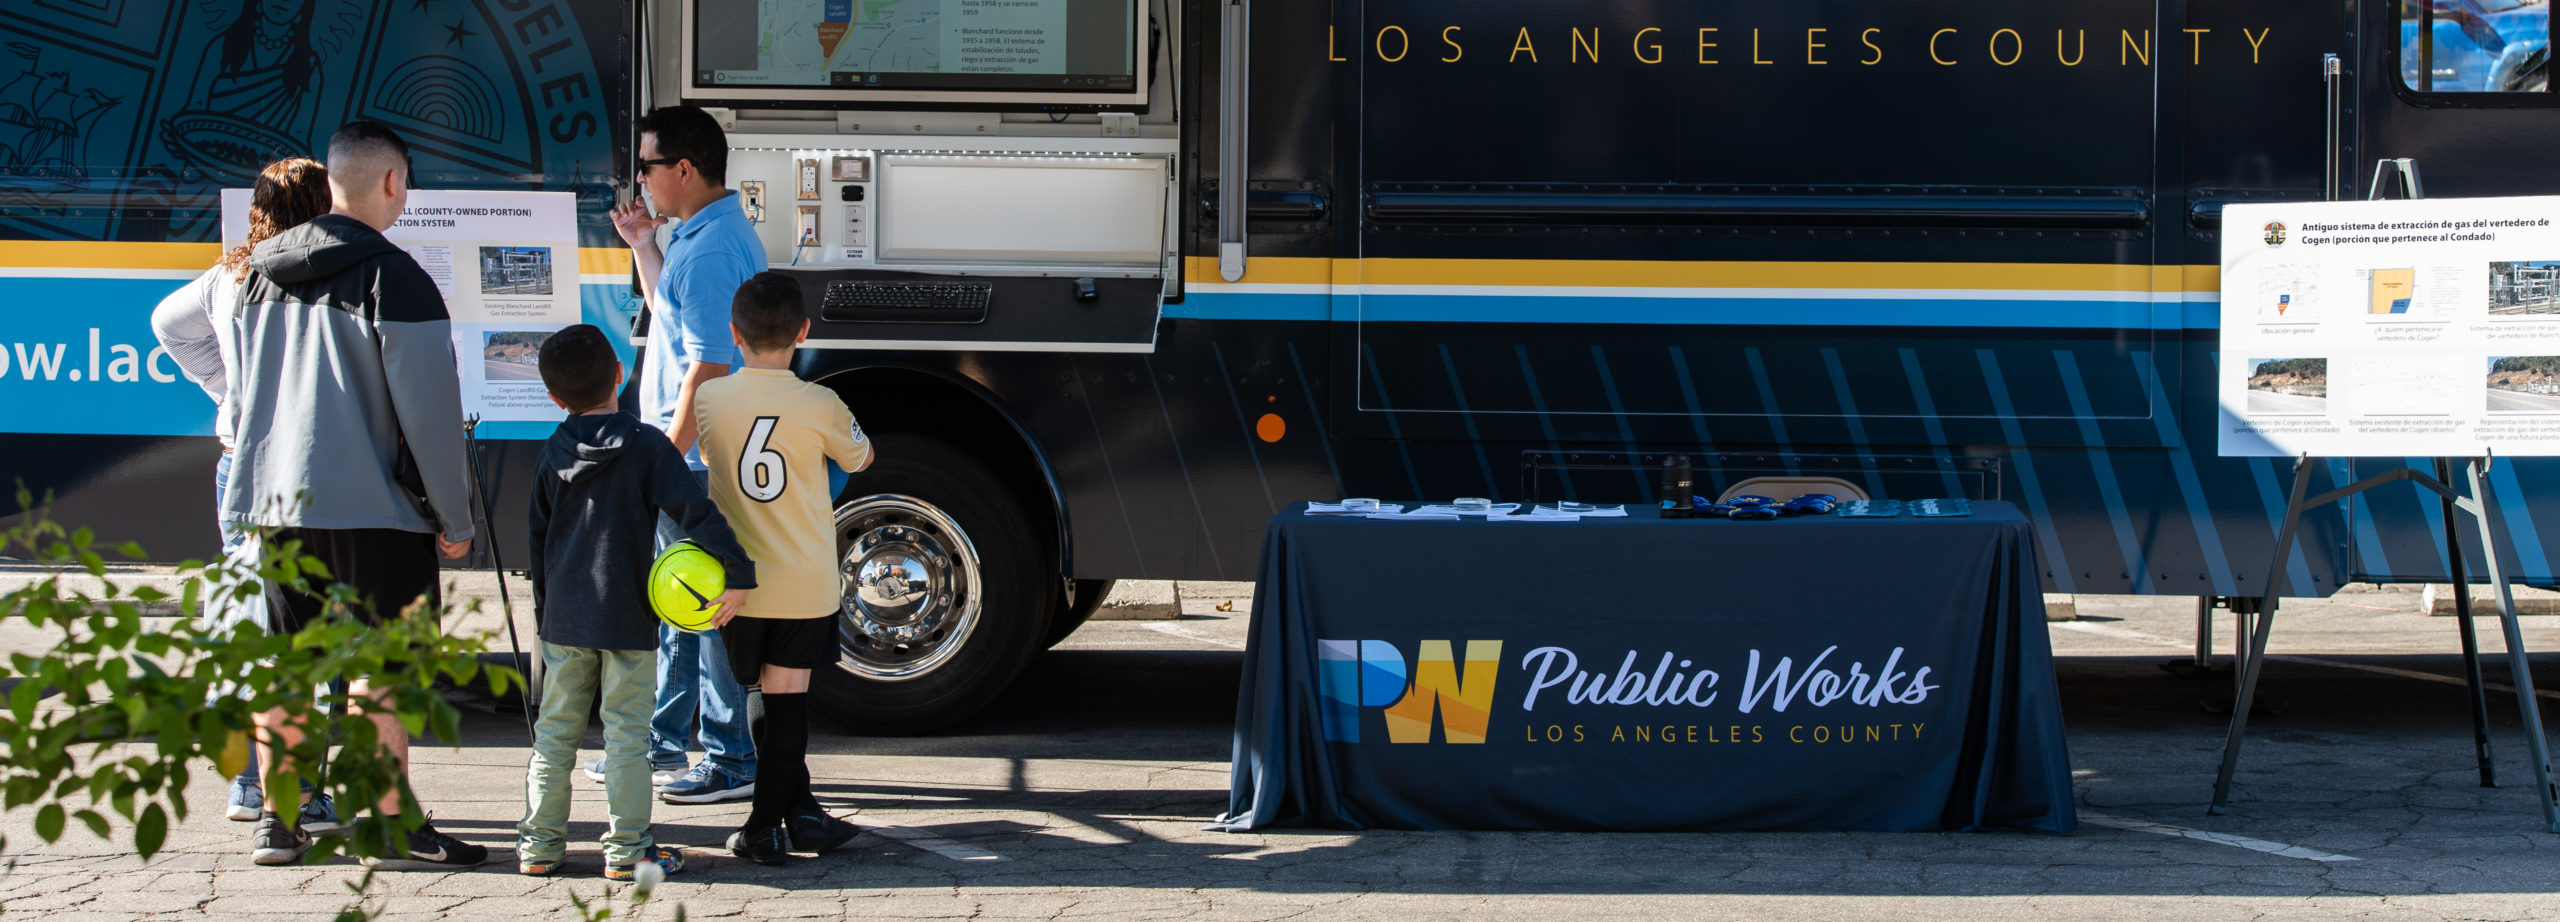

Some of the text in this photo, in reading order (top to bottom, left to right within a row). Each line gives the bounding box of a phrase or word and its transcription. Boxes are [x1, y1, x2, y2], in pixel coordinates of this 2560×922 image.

[961, 46, 1005, 54] estabilización
[1015, 47, 1041, 55] taludes,
[1330, 26, 2270, 67] LOS ANGELES COUNTY
[961, 56, 978, 64] riego
[415, 207, 489, 216] (COUNTY-OWNED
[490, 208, 532, 217] PORTION)
[421, 219, 456, 227] SYSTEM
[2302, 218, 2549, 233] Antiguo sistema de extracción de gas del vertedero de
[2302, 232, 2495, 246] Cogen (porción que pertenece al Condado)
[739, 416, 787, 503] 6
[1523, 645, 1940, 713] Public Works
[1528, 723, 1926, 743] LOS ANGELES COUNTY
